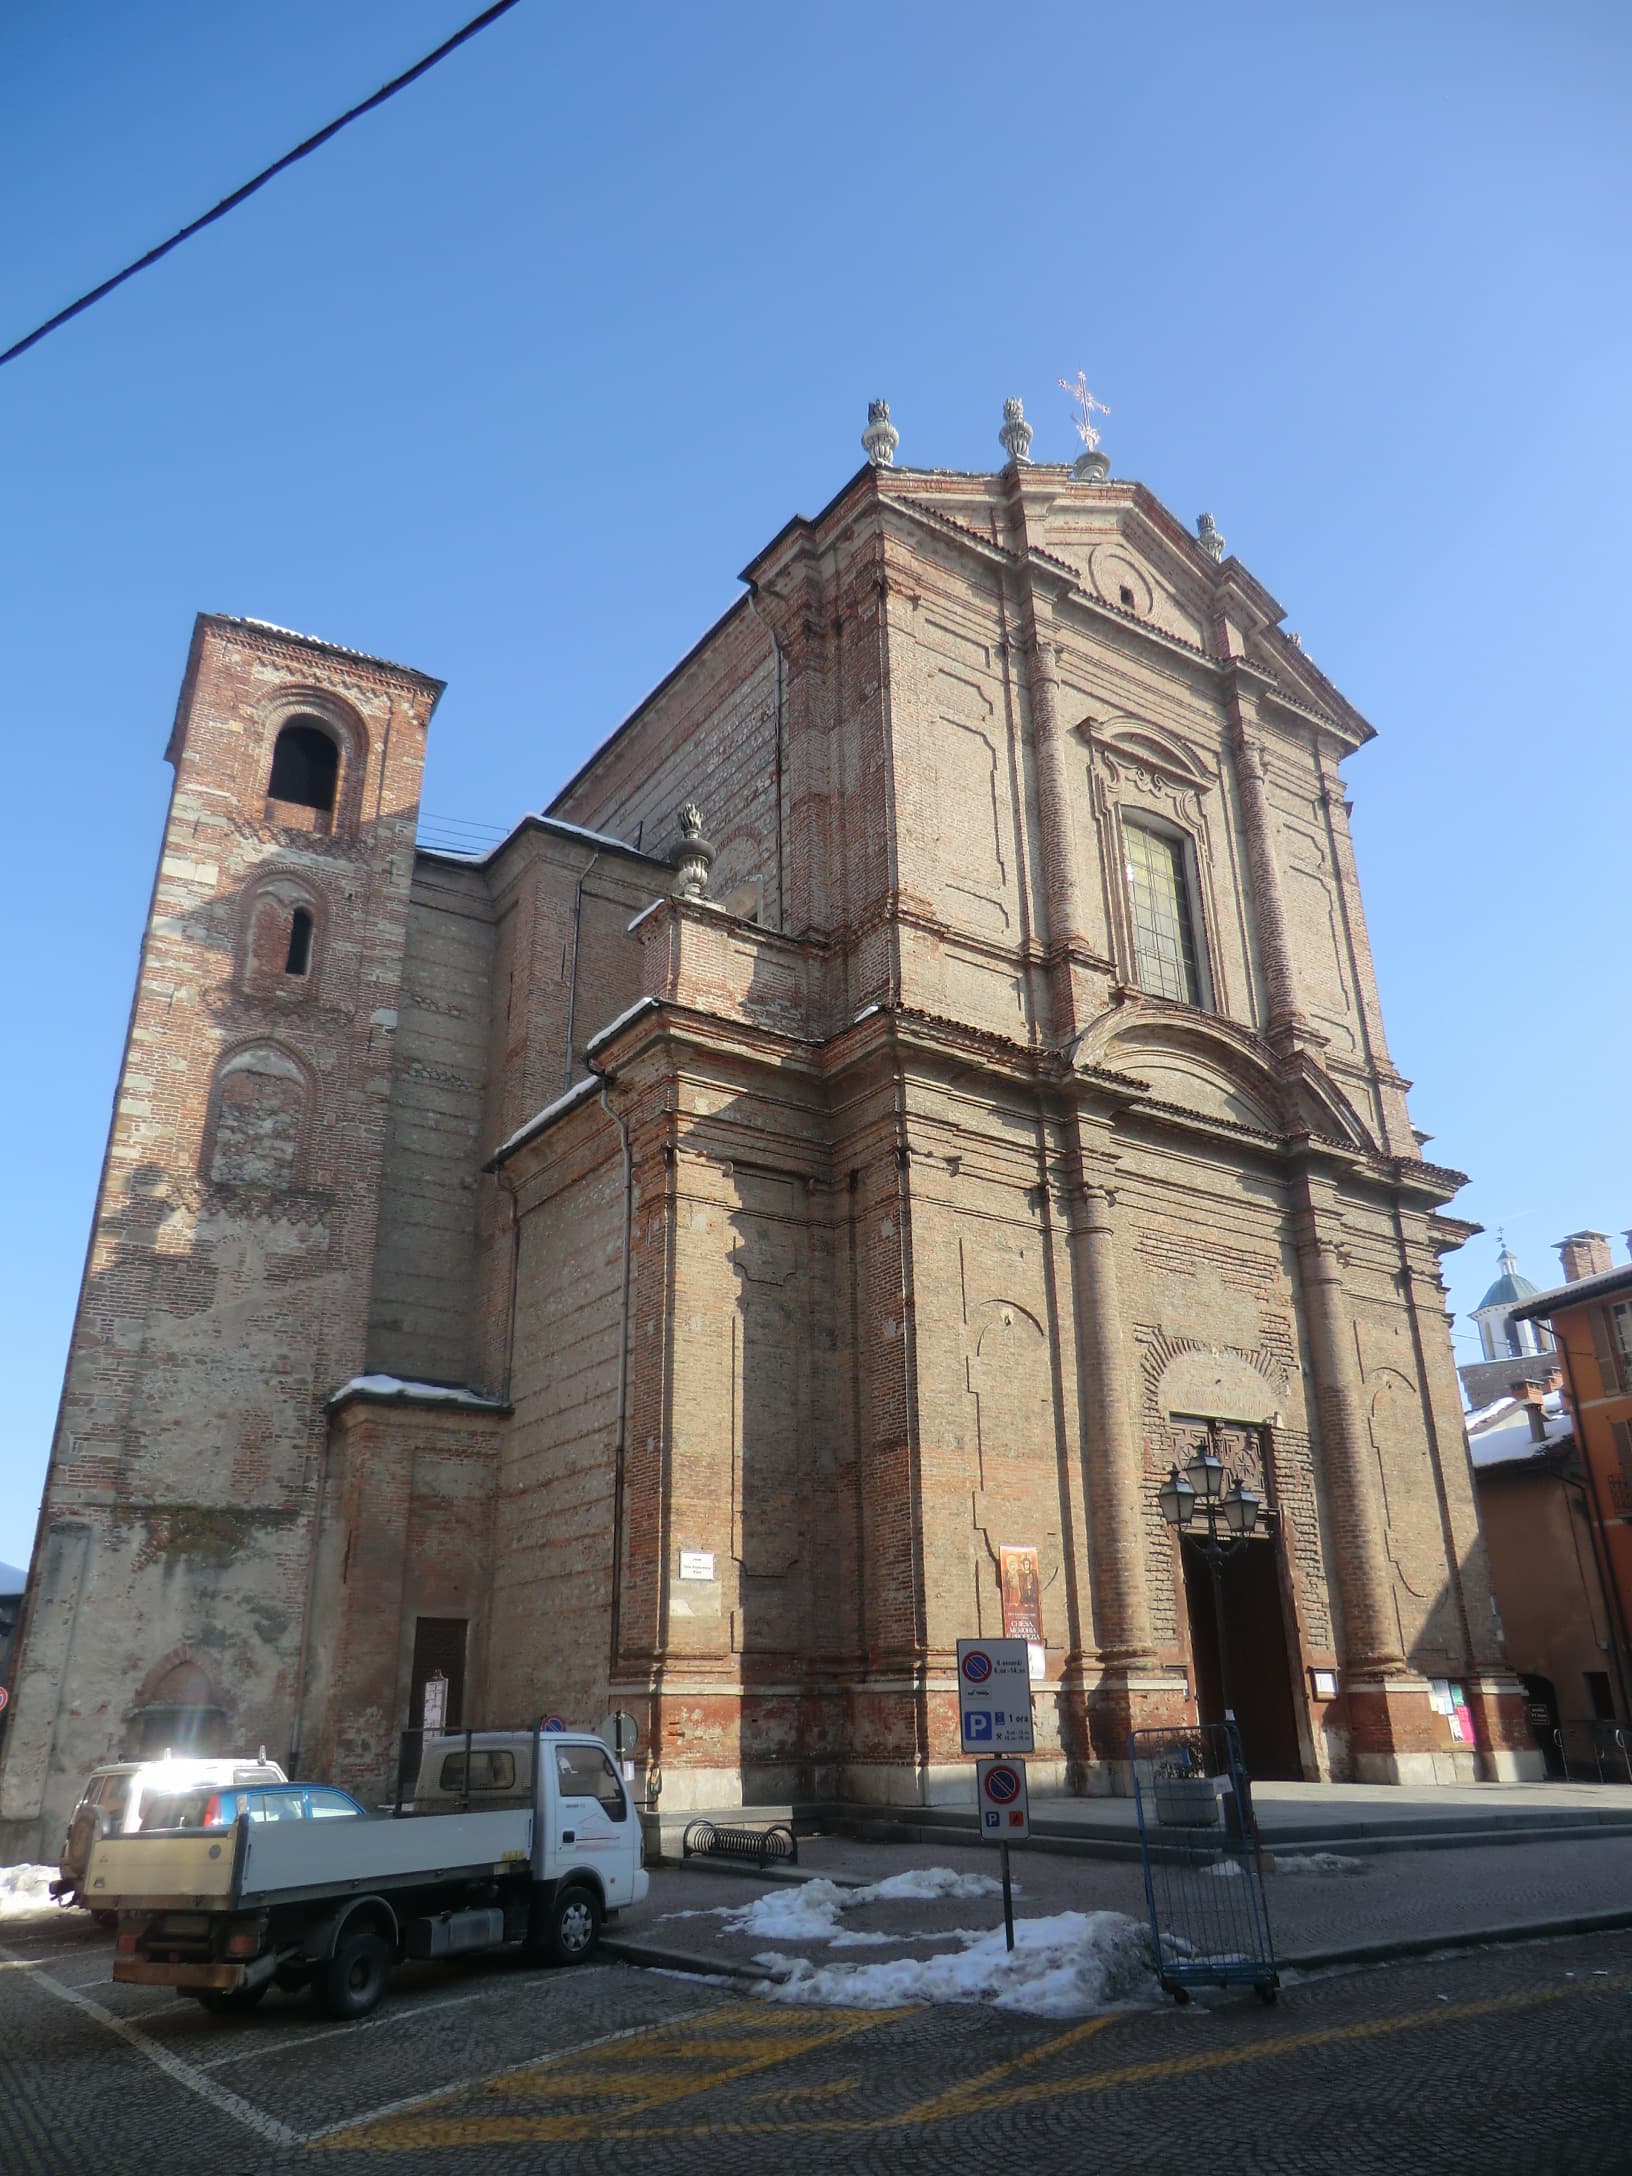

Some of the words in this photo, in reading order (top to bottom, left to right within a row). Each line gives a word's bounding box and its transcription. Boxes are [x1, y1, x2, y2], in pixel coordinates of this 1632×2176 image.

[1010, 1620, 1034, 1628] CHIESA
[1009, 1713, 1013, 1723] 1
[1015, 1715, 1029, 1723] ora
[969, 1714, 987, 1737] P
[988, 1814, 998, 1826] P
